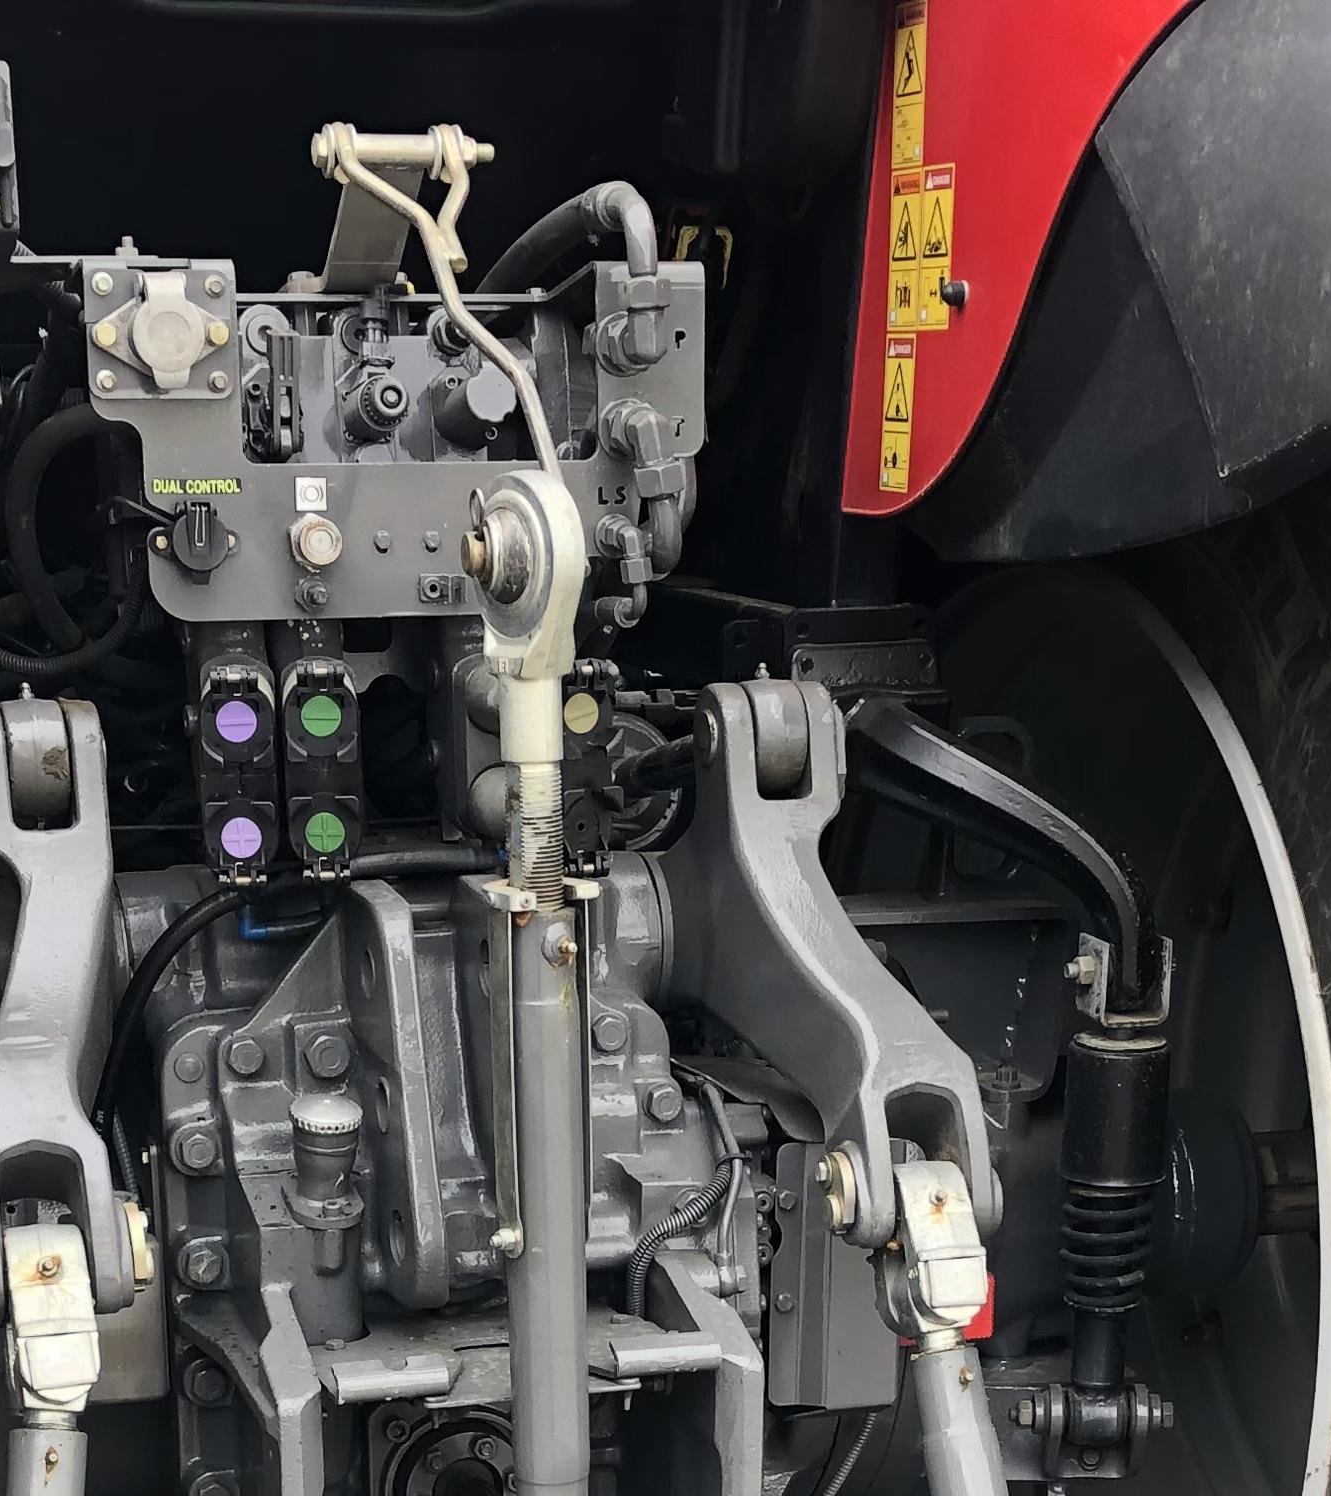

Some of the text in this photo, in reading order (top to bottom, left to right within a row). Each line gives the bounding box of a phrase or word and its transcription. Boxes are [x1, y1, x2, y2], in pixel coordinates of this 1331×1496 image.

[674, 330, 686, 349] P
[153, 479, 241, 495] DUAL CONTROL
